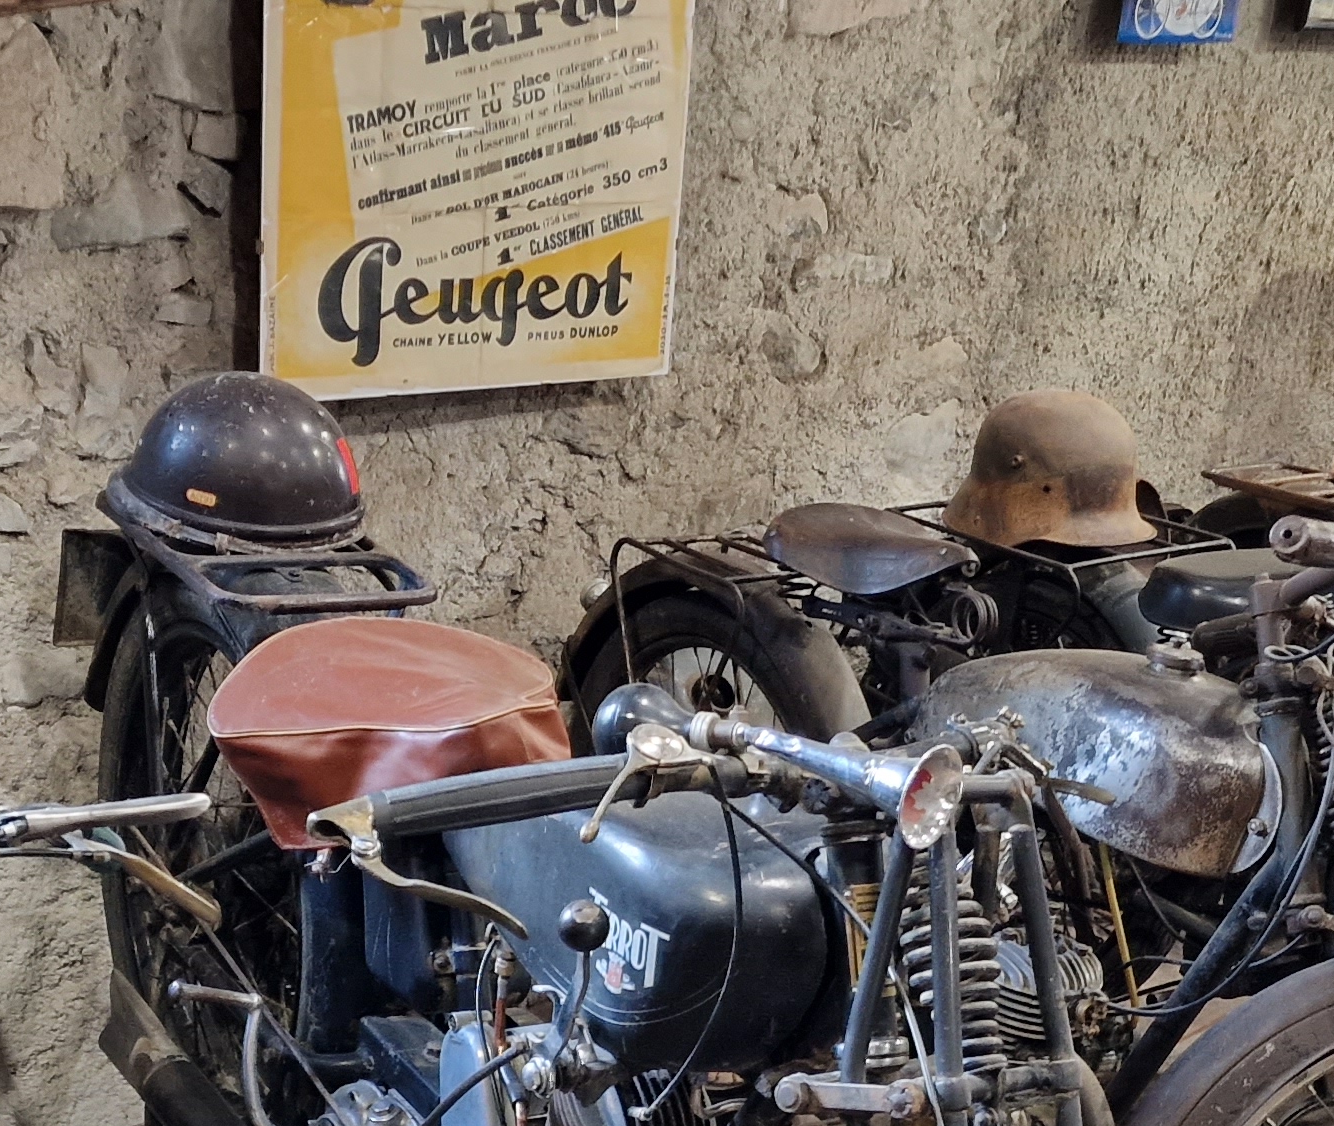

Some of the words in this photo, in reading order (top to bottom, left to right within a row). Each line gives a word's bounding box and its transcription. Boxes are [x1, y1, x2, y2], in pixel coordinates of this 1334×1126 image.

[347, 100, 416, 134] TRAMOY
[424, 92, 472, 114] remporte
[476, 87, 487, 101] la
[513, 72, 551, 94] place
[588, 84, 623, 104] brillant
[629, 71, 661, 90] second
[350, 134, 376, 152] dans
[382, 128, 393, 142] le
[402, 107, 470, 138] CIRCUIT
[481, 98, 502, 118] DU
[512, 88, 546, 109] SUD
[455, 145, 469, 159] du
[473, 128, 530, 154] classement
[358, 178, 428, 210] confirmant
[430, 169, 461, 190] ainsi
[504, 147, 543, 169] succès
[502, 172, 564, 201] MAROCAIN
[527, 183, 595, 211] Catégorie
[602, 170, 631, 190] 350
[637, 157, 668, 180] cm3
[416, 254, 438, 267] Dans
[440, 249, 449, 259] la
[451, 237, 490, 257] COUPE
[494, 221, 540, 243] VEEDOL
[529, 219, 595, 256] CLASSEMENT
[318, 236, 632, 367] Peugeot
[392, 336, 433, 348] CHAINE
[437, 331, 493, 347] YELLOW
[527, 330, 564, 341] PNEUS
[570, 325, 619, 339] DUNLOP
[589, 887, 670, 989] TRROT
